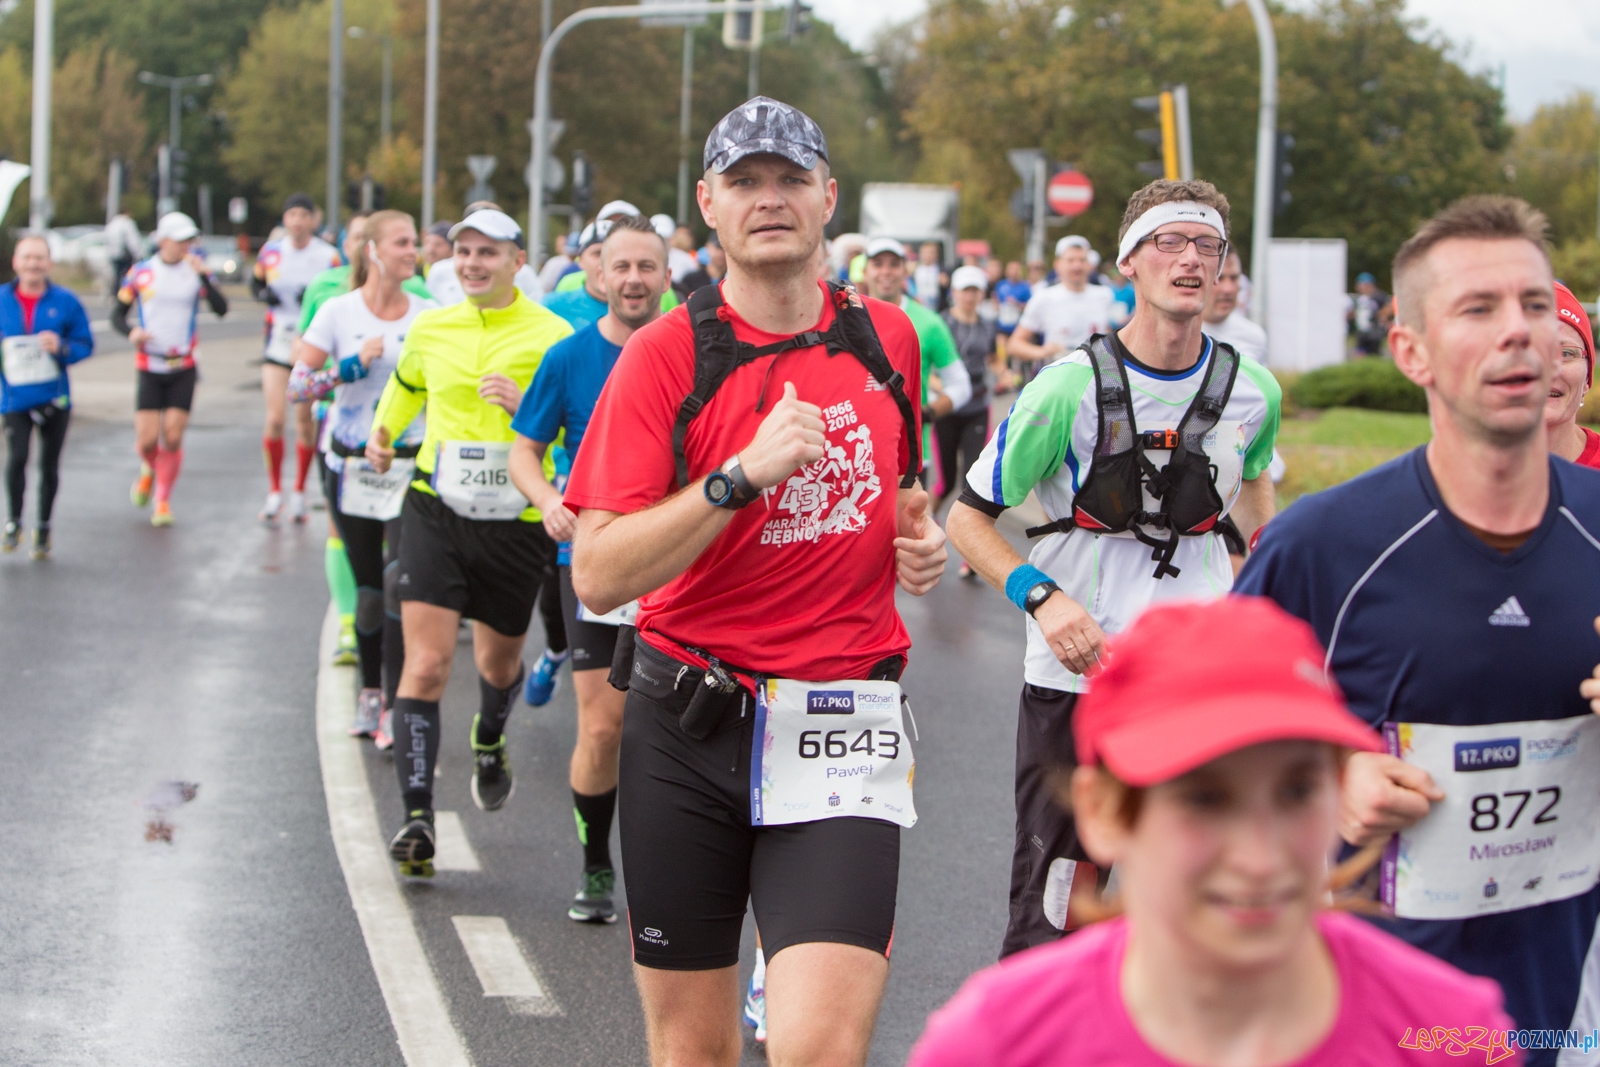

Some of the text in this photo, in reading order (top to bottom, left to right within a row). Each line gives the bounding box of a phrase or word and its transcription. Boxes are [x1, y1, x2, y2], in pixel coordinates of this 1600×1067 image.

[822, 399, 853, 420] 1966
[827, 411, 858, 432] 2016
[460, 468, 508, 485] 2416
[777, 482, 821, 515] 43
[763, 516, 816, 530] MARATON
[798, 729, 901, 760] 6643
[826, 764, 873, 779] Paweł
[1469, 786, 1561, 832] 872
[1469, 835, 1557, 861] Mirosław
